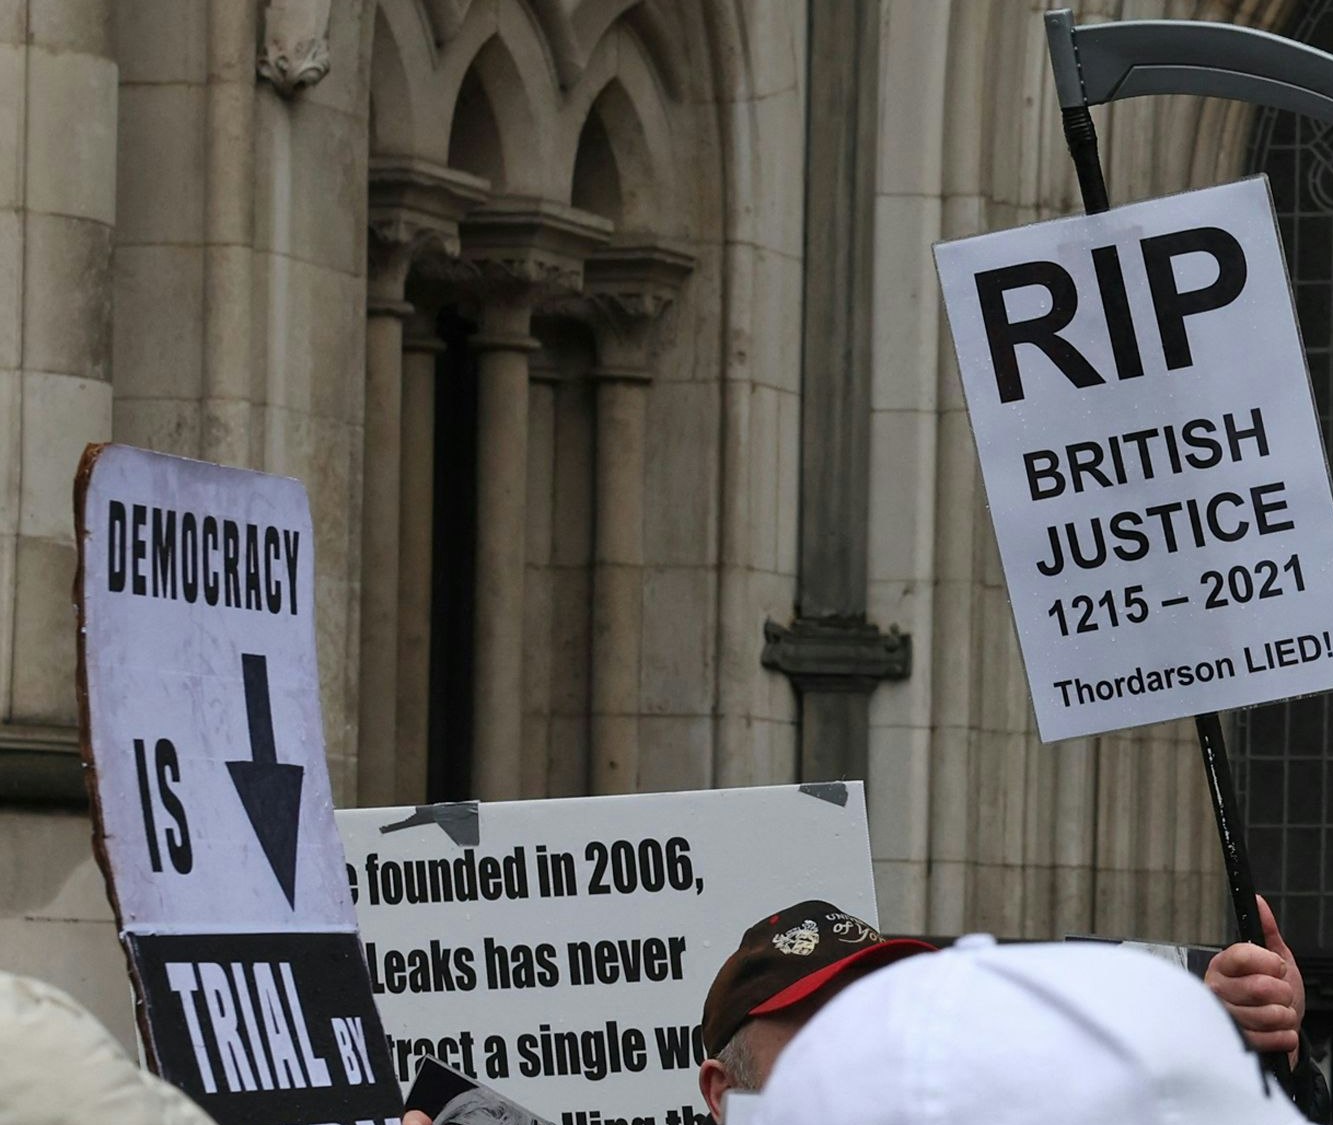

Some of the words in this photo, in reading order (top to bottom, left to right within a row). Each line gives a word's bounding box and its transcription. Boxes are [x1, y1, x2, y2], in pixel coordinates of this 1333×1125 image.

[974, 226, 1248, 404] RIP
[1022, 407, 1270, 501] BRITISH
[107, 499, 301, 616] DEMOCRACY
[1036, 481, 1295, 577] JUSTICE
[1048, 584, 1149, 638] 1215
[1201, 554, 1306, 610] 2021
[1054, 654, 1235, 708] Thordarson
[1242, 630, 1333, 674] LIED!
[133, 737, 193, 875] IS
[365, 847, 529, 905] founded
[536, 845, 578, 898] in
[584, 836, 705, 896] 2006,
[484, 937, 560, 990] has
[567, 935, 687, 987] never
[169, 960, 326, 1095] TRIAL
[336, 1015, 377, 1086] BY
[484, 1034, 510, 1080] a
[517, 1021, 648, 1082] single
